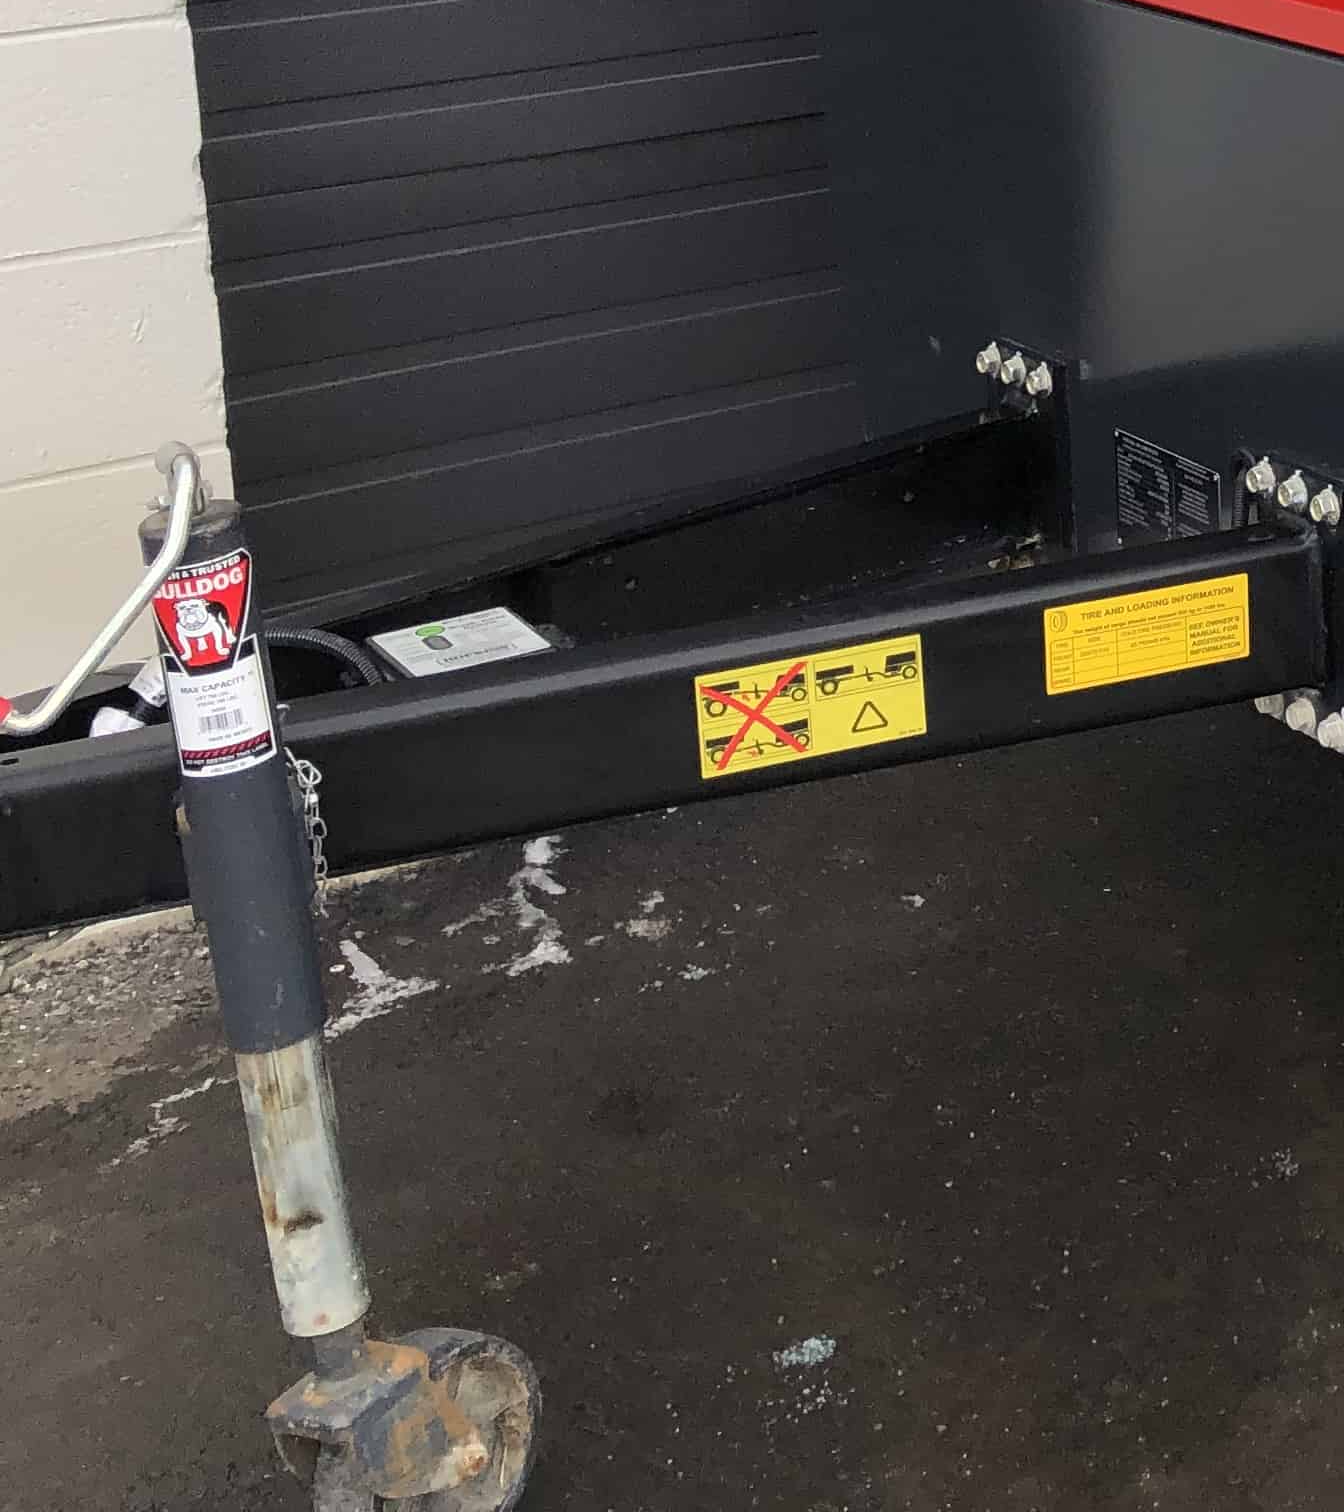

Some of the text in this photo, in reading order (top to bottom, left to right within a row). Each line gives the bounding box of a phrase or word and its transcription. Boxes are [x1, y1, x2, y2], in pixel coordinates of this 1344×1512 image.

[190, 554, 240, 576] TRUSTED
[1080, 586, 1235, 621] TIRE AND LOADING INFORMATION
[180, 686, 200, 695] MAX
[202, 674, 245, 693] CAPACITY
